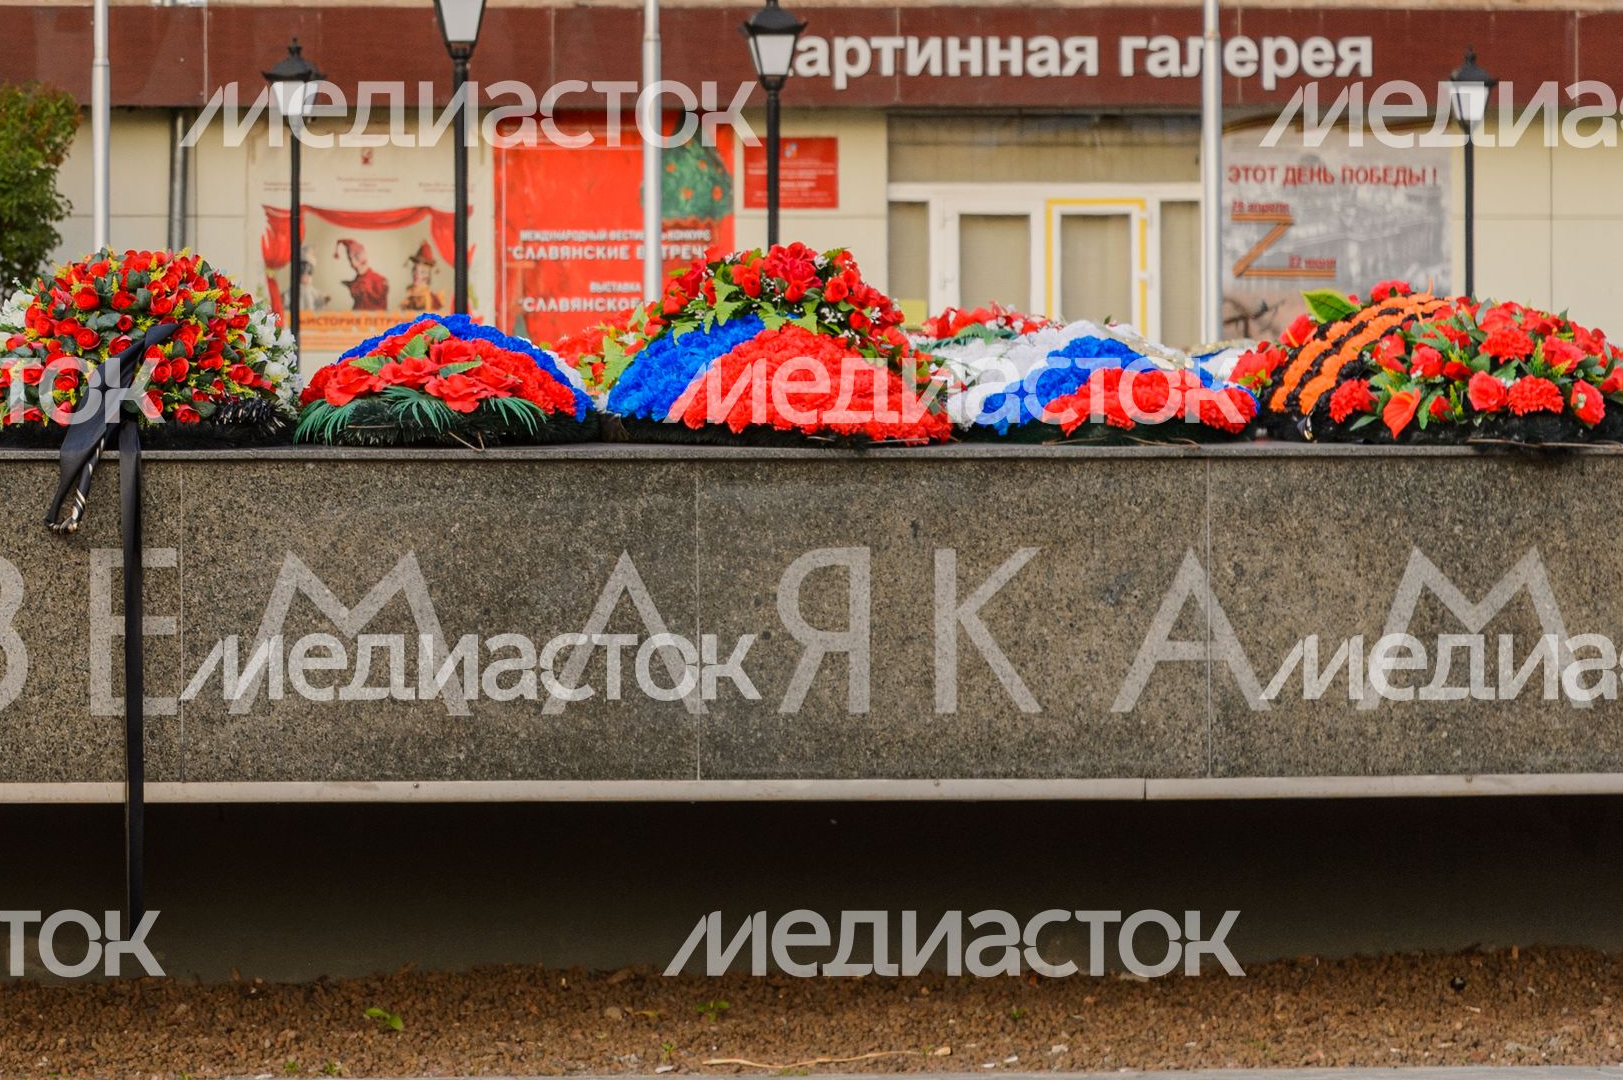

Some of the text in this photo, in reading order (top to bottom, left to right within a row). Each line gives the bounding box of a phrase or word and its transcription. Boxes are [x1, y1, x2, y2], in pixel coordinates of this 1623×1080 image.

[789, 35, 1098, 89] артинная
[1228, 166, 1276, 184] ЭТОТ
[1283, 166, 1335, 188] ДЕНЬ
